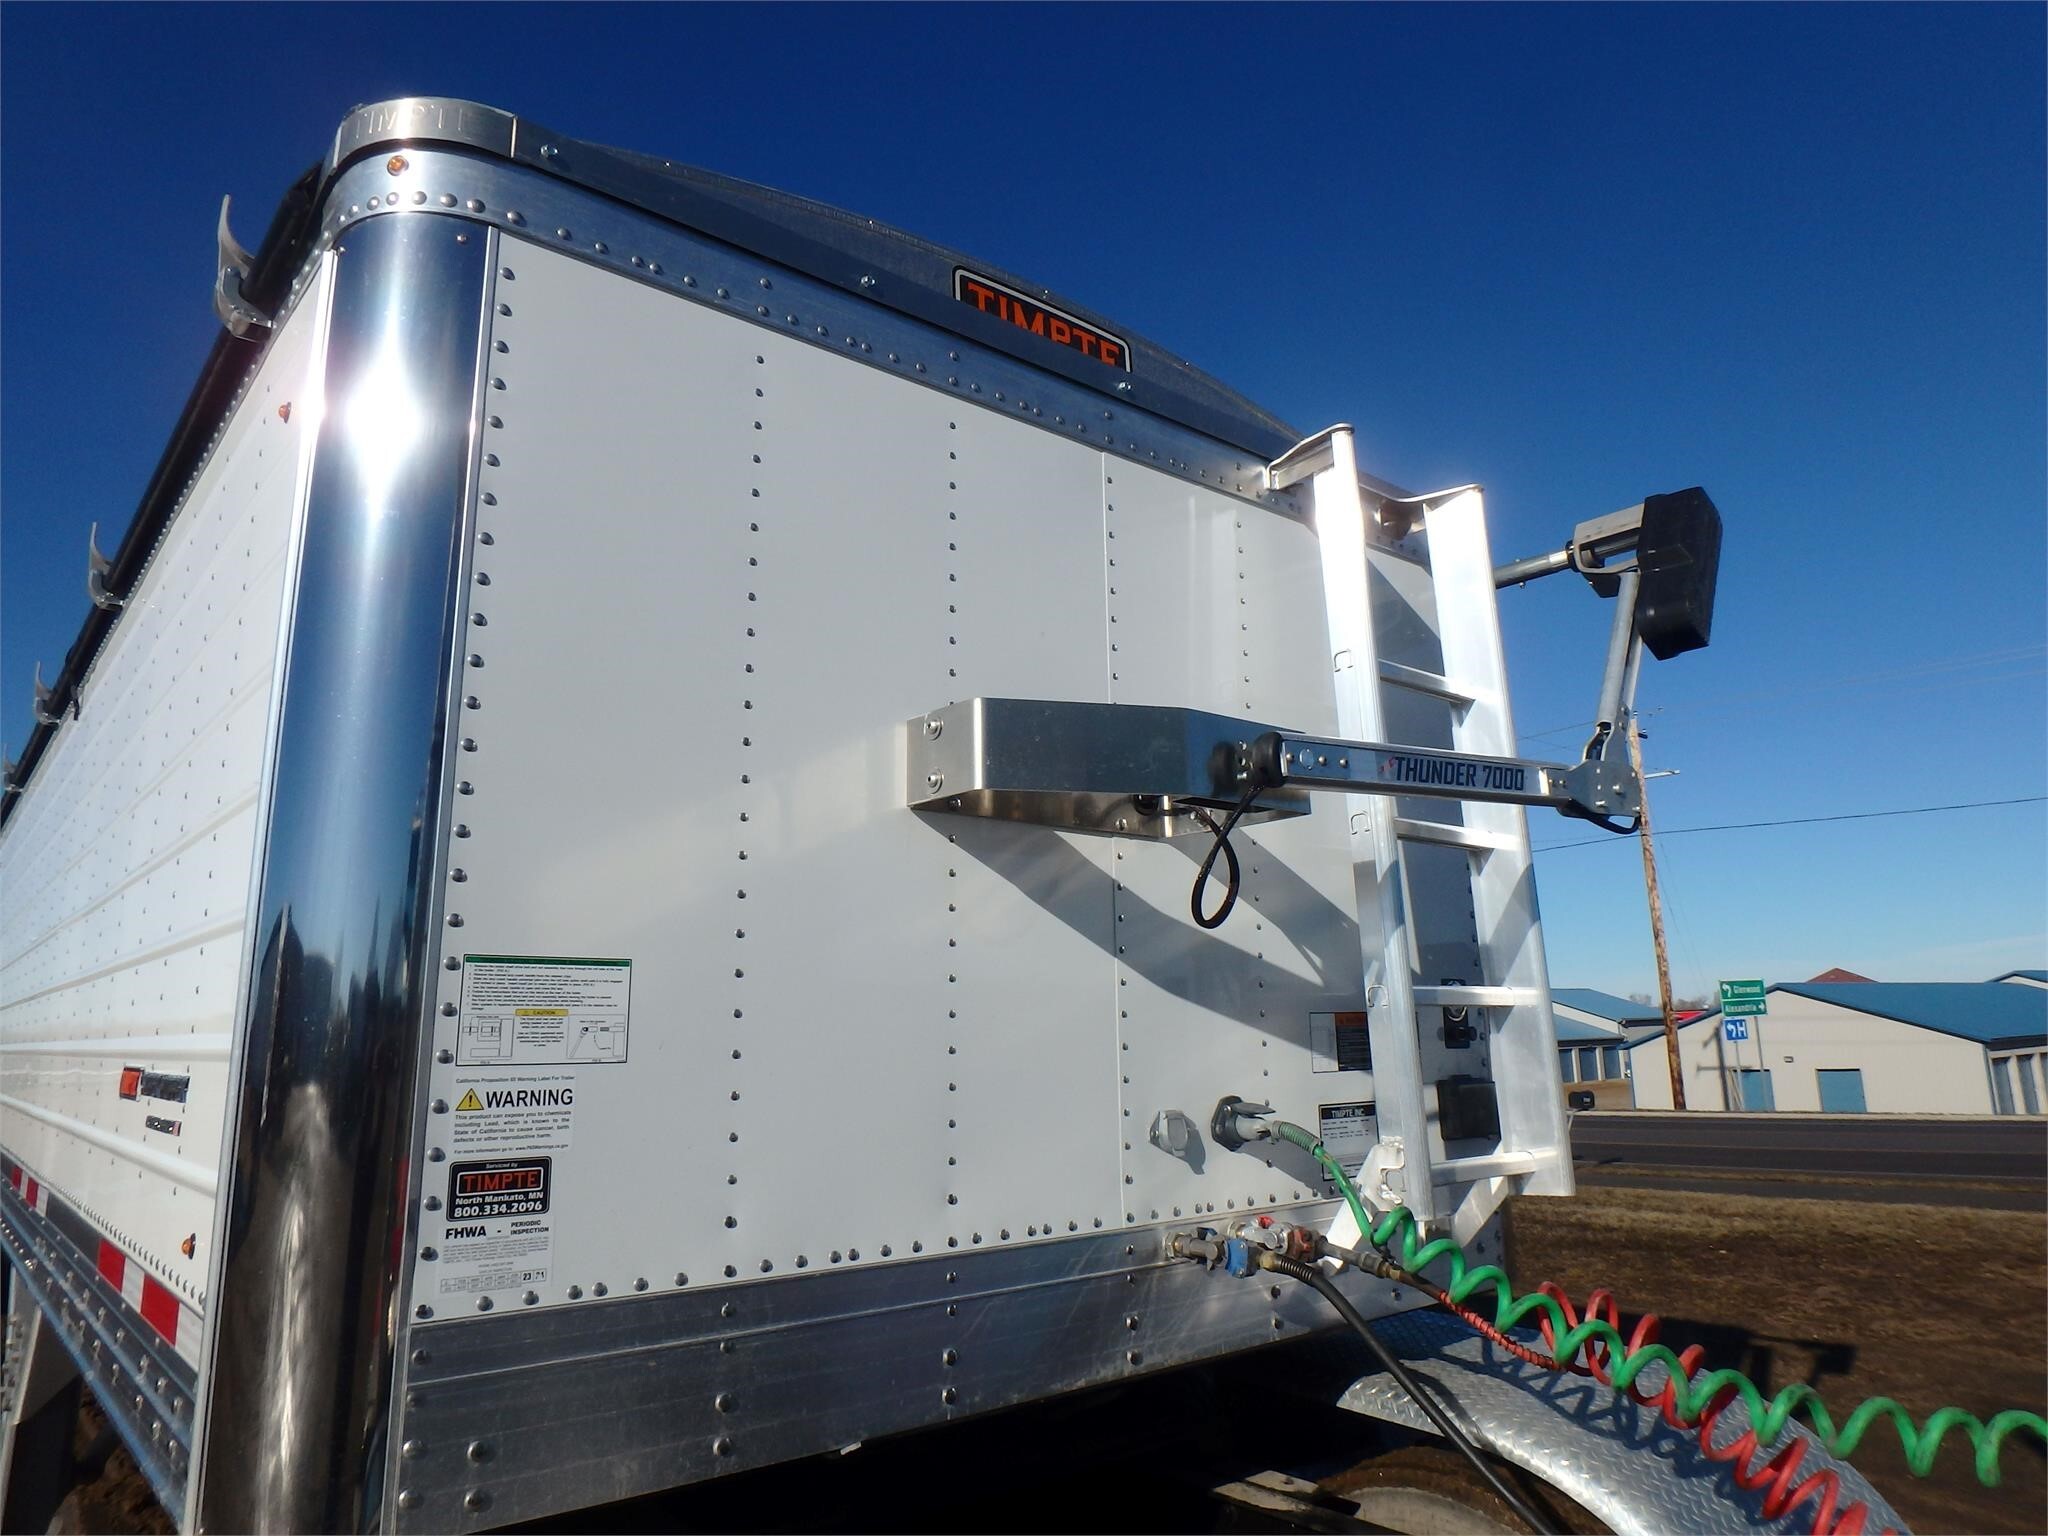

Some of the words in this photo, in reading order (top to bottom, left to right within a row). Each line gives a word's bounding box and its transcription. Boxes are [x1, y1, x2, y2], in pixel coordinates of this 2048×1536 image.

[1395, 756, 1477, 787] THUNDER
[1482, 765, 1525, 791] 7000
[1736, 1021, 1747, 1037] H
[486, 1089, 573, 1108] WARNING
[1331, 1110, 1353, 1118] TIMPTE
[463, 1171, 538, 1192] TIMPTE
[455, 1197, 482, 1205] North
[485, 1194, 526, 1202] Mankato,
[454, 1201, 542, 1217] 800.334.2096
[445, 1226, 486, 1239] FHWA
[511, 1227, 549, 1235] INSPECTION
